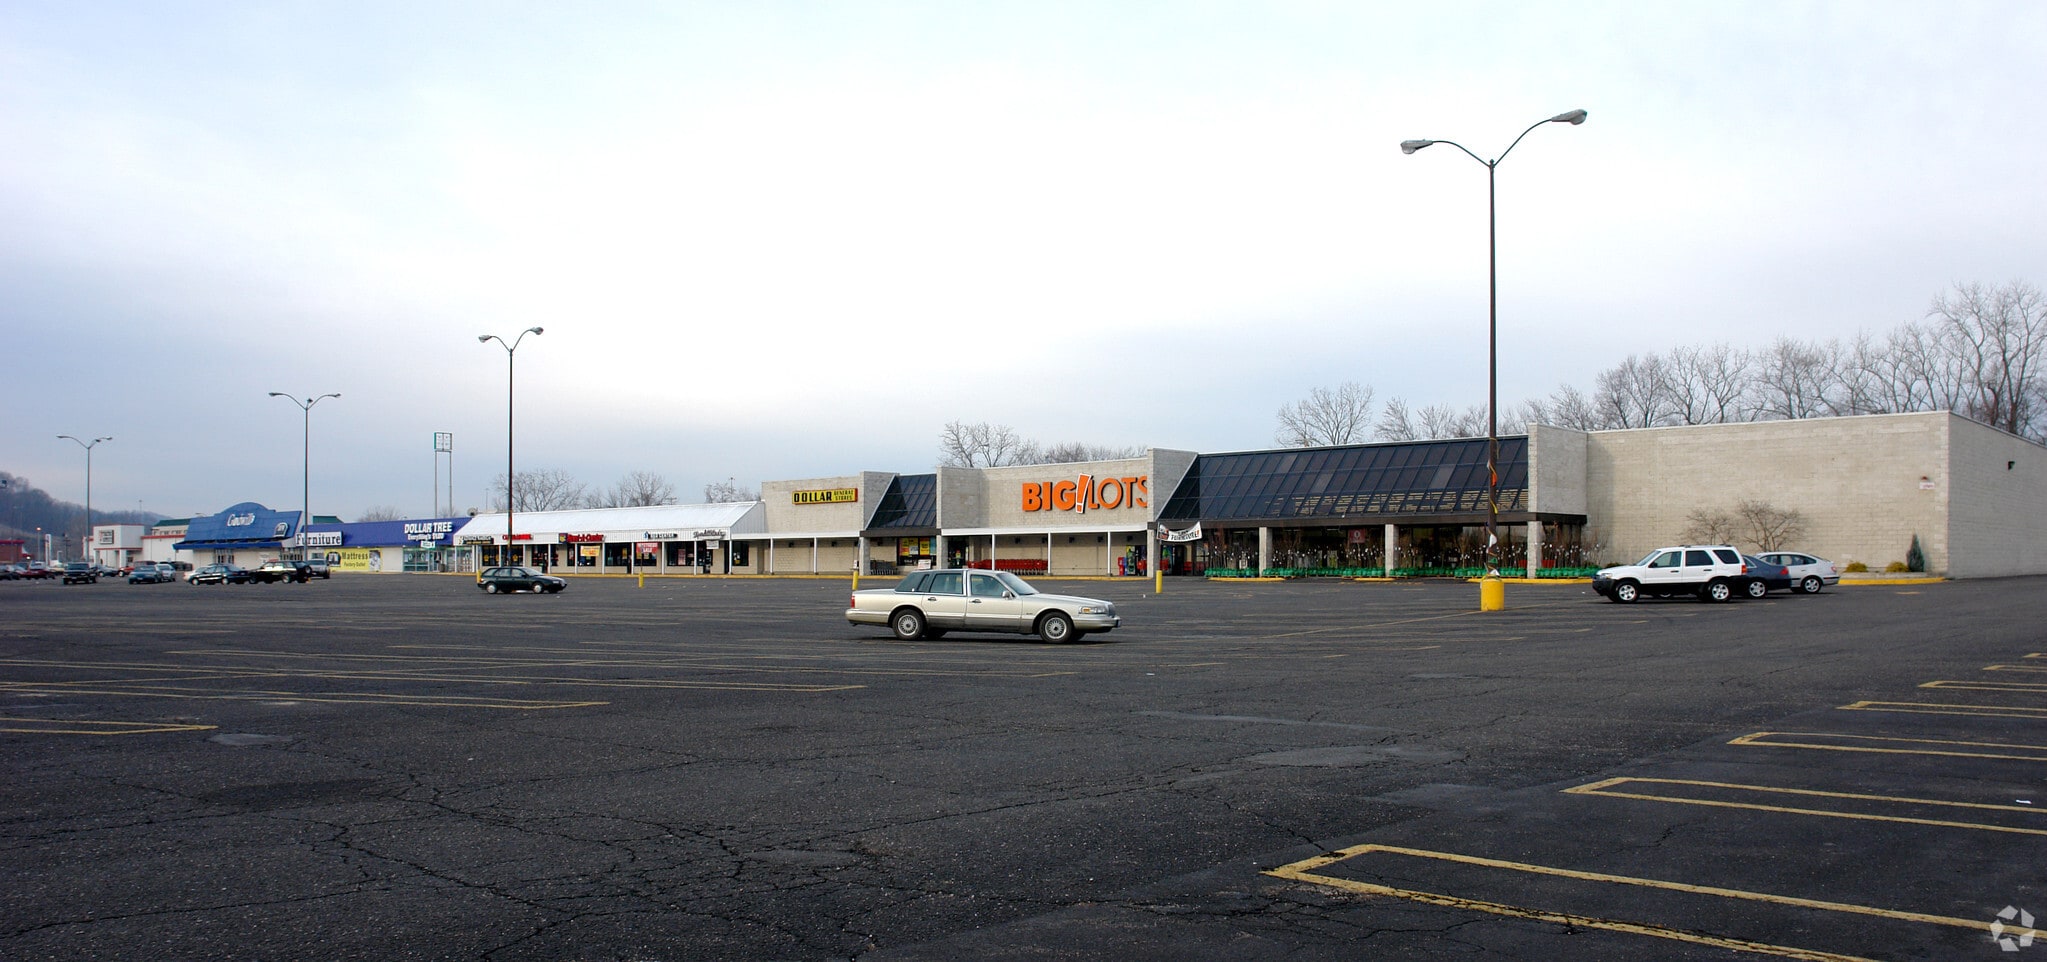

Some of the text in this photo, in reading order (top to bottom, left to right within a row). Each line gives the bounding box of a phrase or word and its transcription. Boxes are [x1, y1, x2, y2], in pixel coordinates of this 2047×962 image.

[794, 491, 832, 502] DOLLAR
[404, 521, 452, 533] DOLLAR TREE
[342, 552, 368, 560] Mattress
